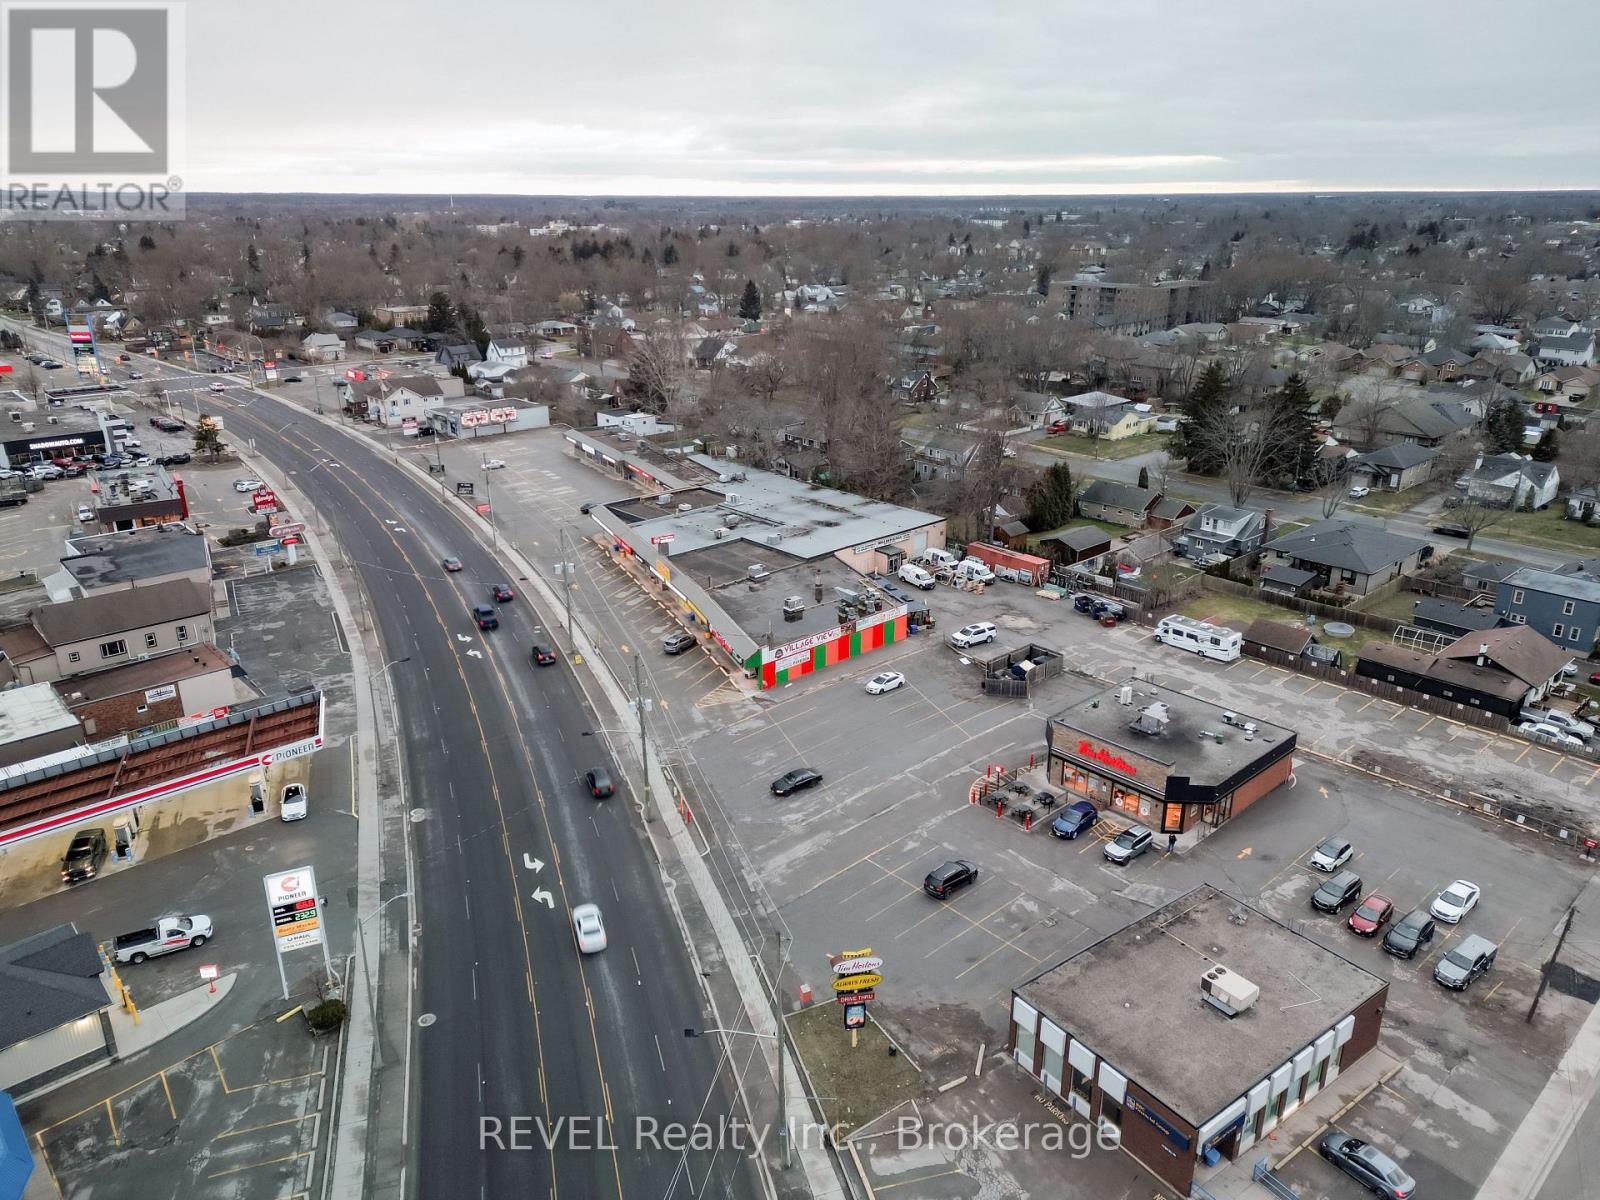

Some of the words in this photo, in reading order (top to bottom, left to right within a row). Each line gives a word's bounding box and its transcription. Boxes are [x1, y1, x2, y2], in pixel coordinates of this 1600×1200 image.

[784, 638, 814, 652] VILLAGE
[816, 631, 834, 641] VIEW
[276, 743, 314, 760] PIONEER
[278, 891, 306, 901] PIONEER
[838, 963, 850, 972] Tim
[851, 960, 880, 970] Hortons
[859, 977, 880, 985] FRESH
